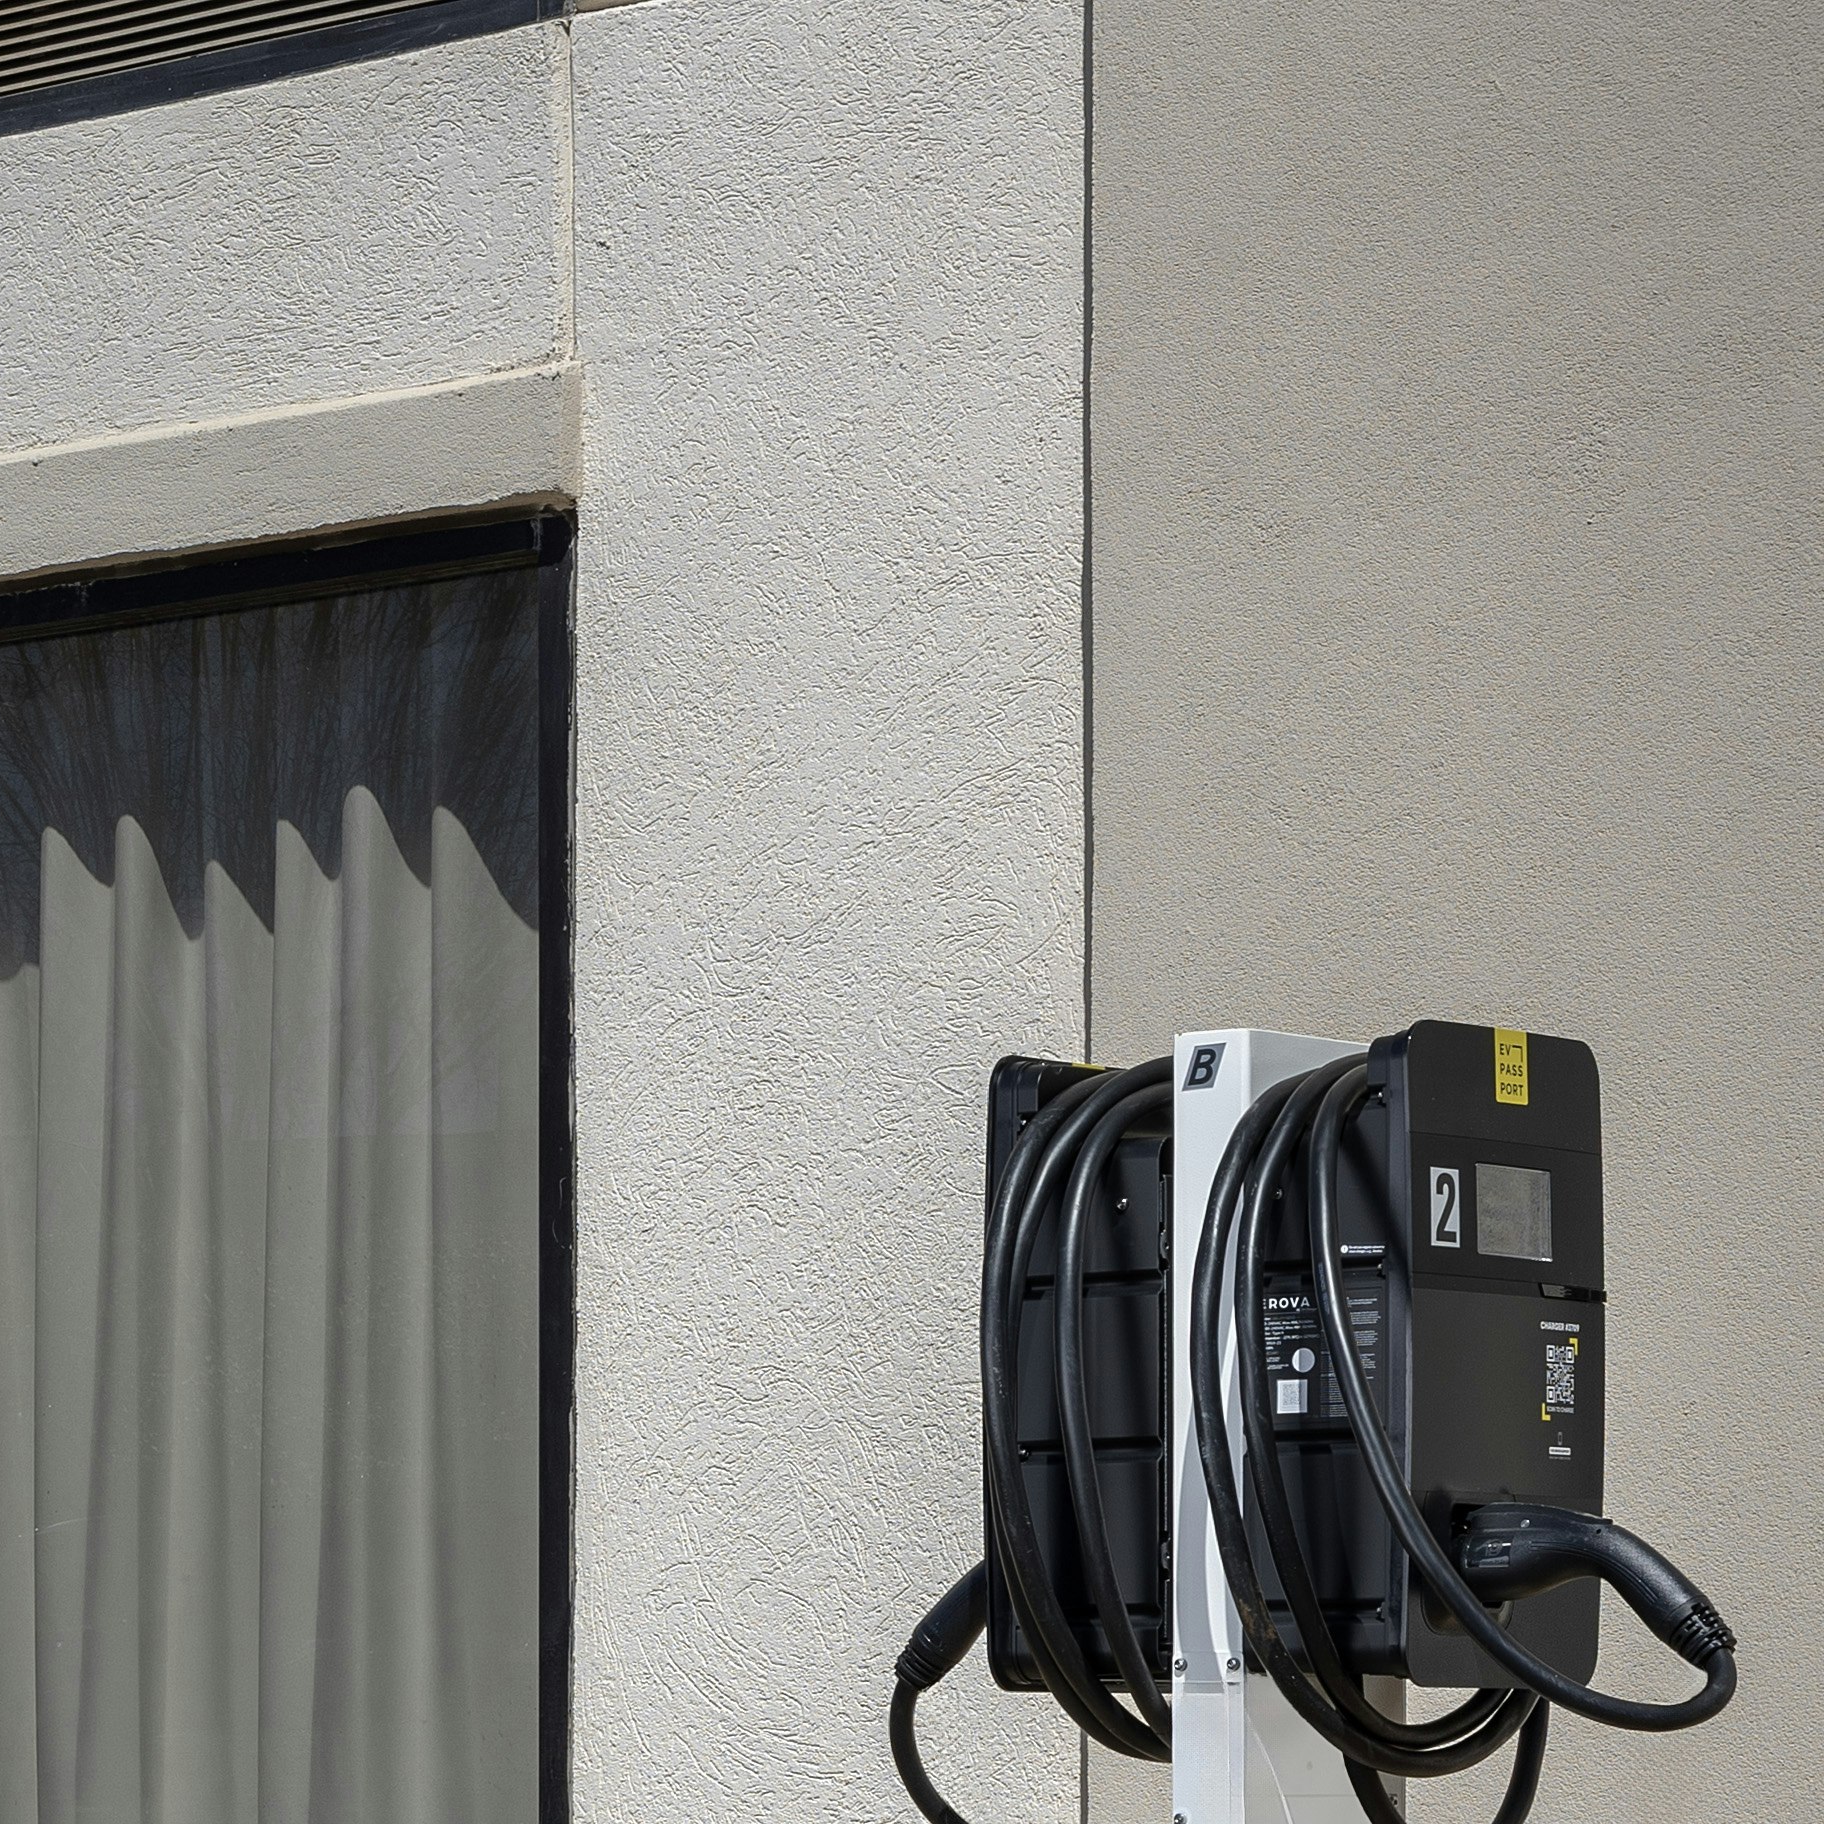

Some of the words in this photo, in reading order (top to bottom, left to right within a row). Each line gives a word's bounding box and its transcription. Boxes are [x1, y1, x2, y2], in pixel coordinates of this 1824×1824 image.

[1499, 1043, 1512, 1056] EV
[1188, 1049, 1217, 1087] B
[1500, 1062, 1523, 1077] PASS
[1500, 1082, 1523, 1097] PORT
[1436, 1172, 1456, 1244] 2
